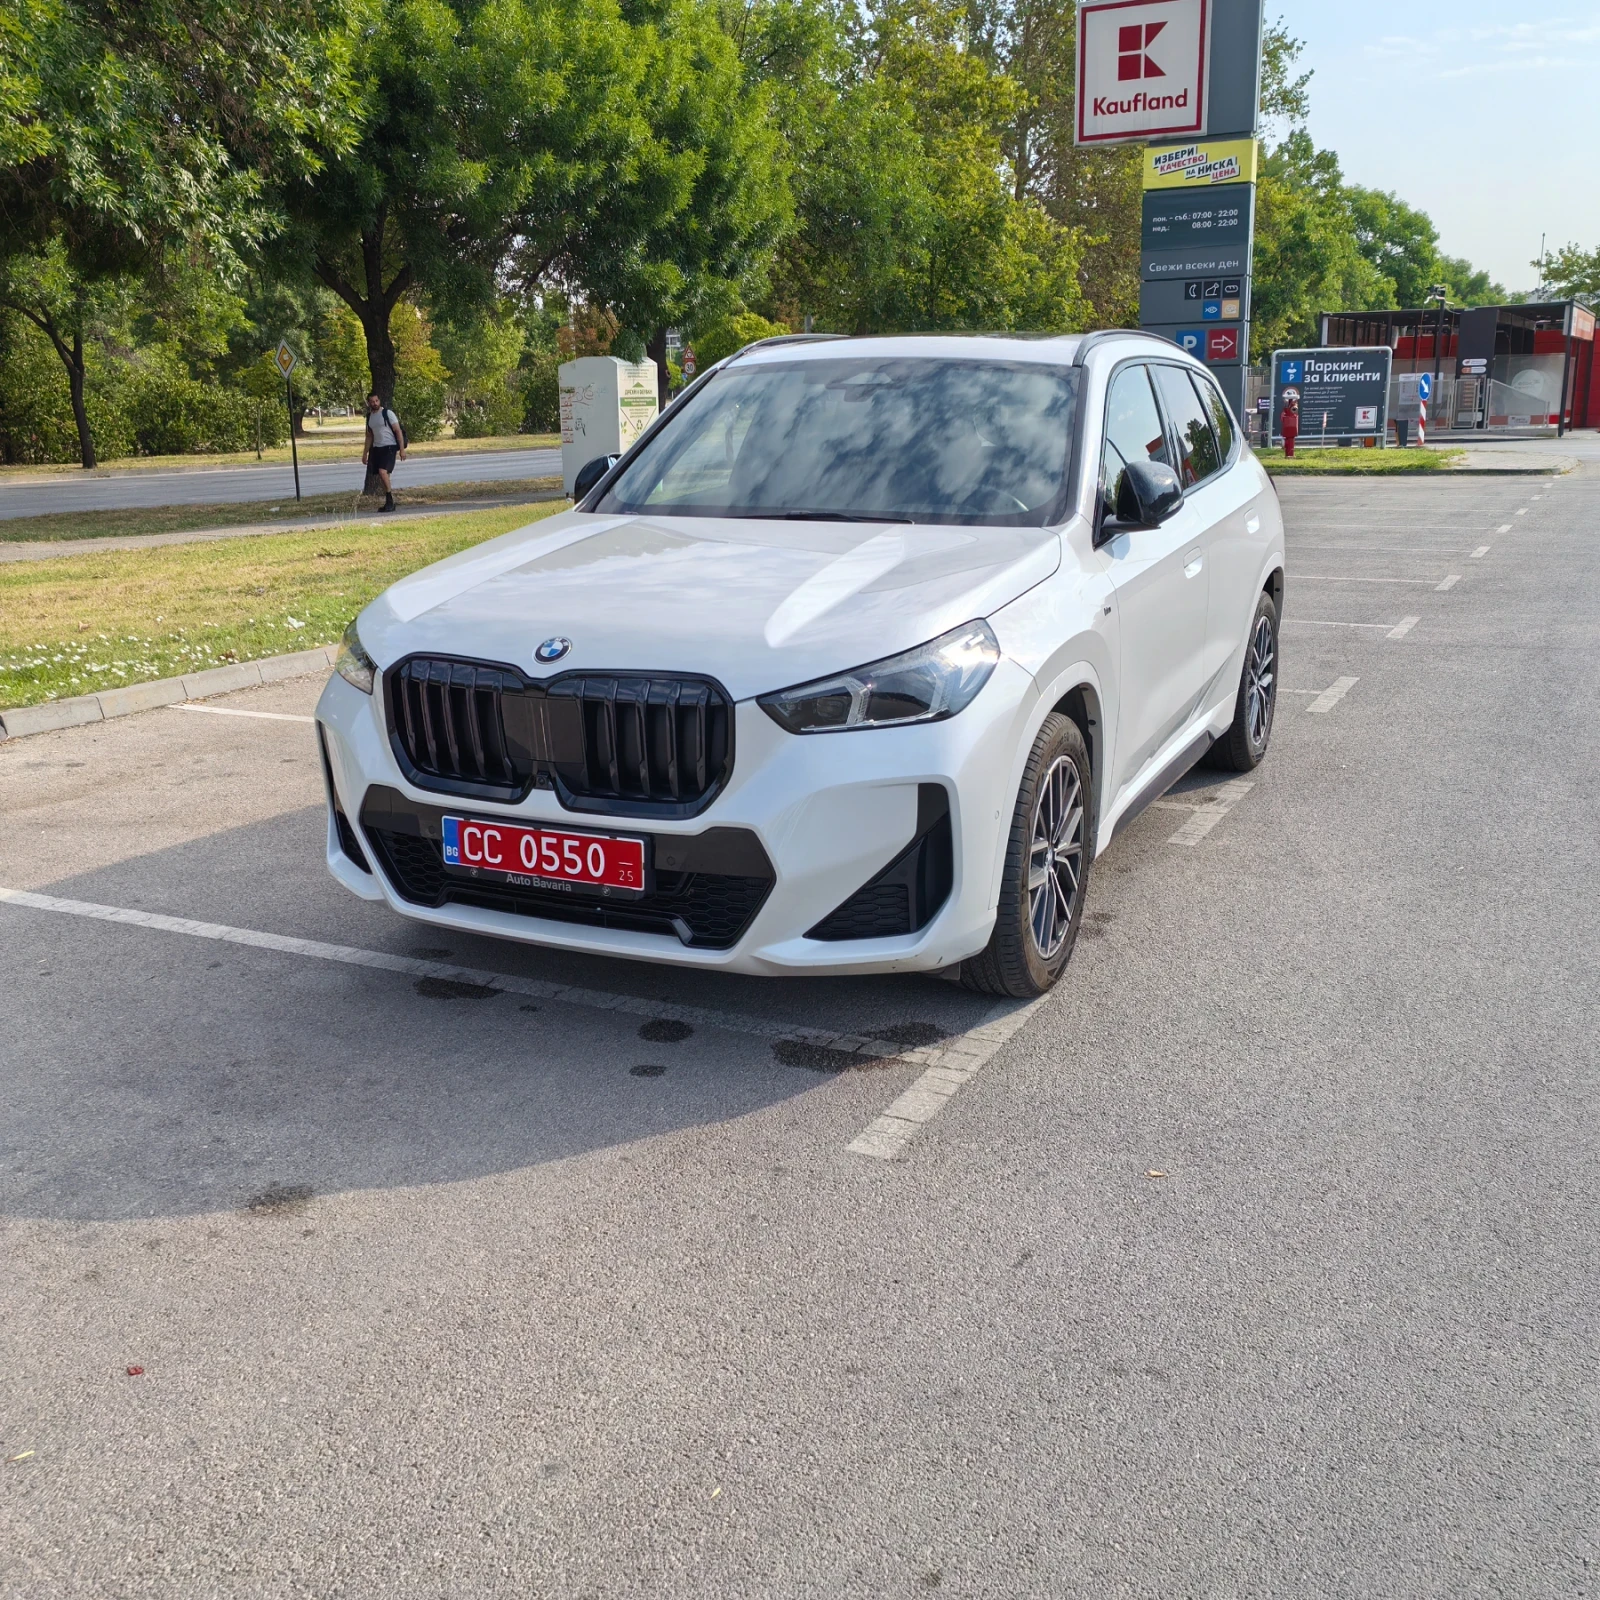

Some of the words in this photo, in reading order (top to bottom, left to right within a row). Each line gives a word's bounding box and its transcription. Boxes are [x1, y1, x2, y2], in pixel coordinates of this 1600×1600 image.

[1118, 21, 1168, 81] K
[1093, 88, 1188, 116] Kaufland
[1154, 147, 1194, 165] ИЗБЕРИ
[1160, 154, 1204, 173] КАЧЕСТВО
[1186, 168, 1196, 176] НА
[1197, 158, 1233, 175] НИСКА
[1212, 167, 1236, 181] ЦЕНА
[1192, 211, 1212, 220] 07:00
[1218, 209, 1238, 217] 22:00
[1192, 220, 1212, 229] 08:00
[1218, 219, 1238, 227] 22:00
[1149, 262, 1182, 272] Свежи
[1186, 260, 1215, 270] всеки
[1218, 260, 1239, 269] ден
[1183, 335, 1197, 348] P
[686, 363, 693, 372] 30
[1304, 360, 1364, 373] Паркинг
[1304, 374, 1319, 383] за
[1323, 372, 1380, 383] клиенти
[446, 846, 458, 857] BG
[463, 827, 502, 864] CC
[519, 834, 605, 877] 0550
[619, 870, 634, 882] 25
[506, 873, 531, 886] Auto
[532, 876, 572, 892] Bavaria
